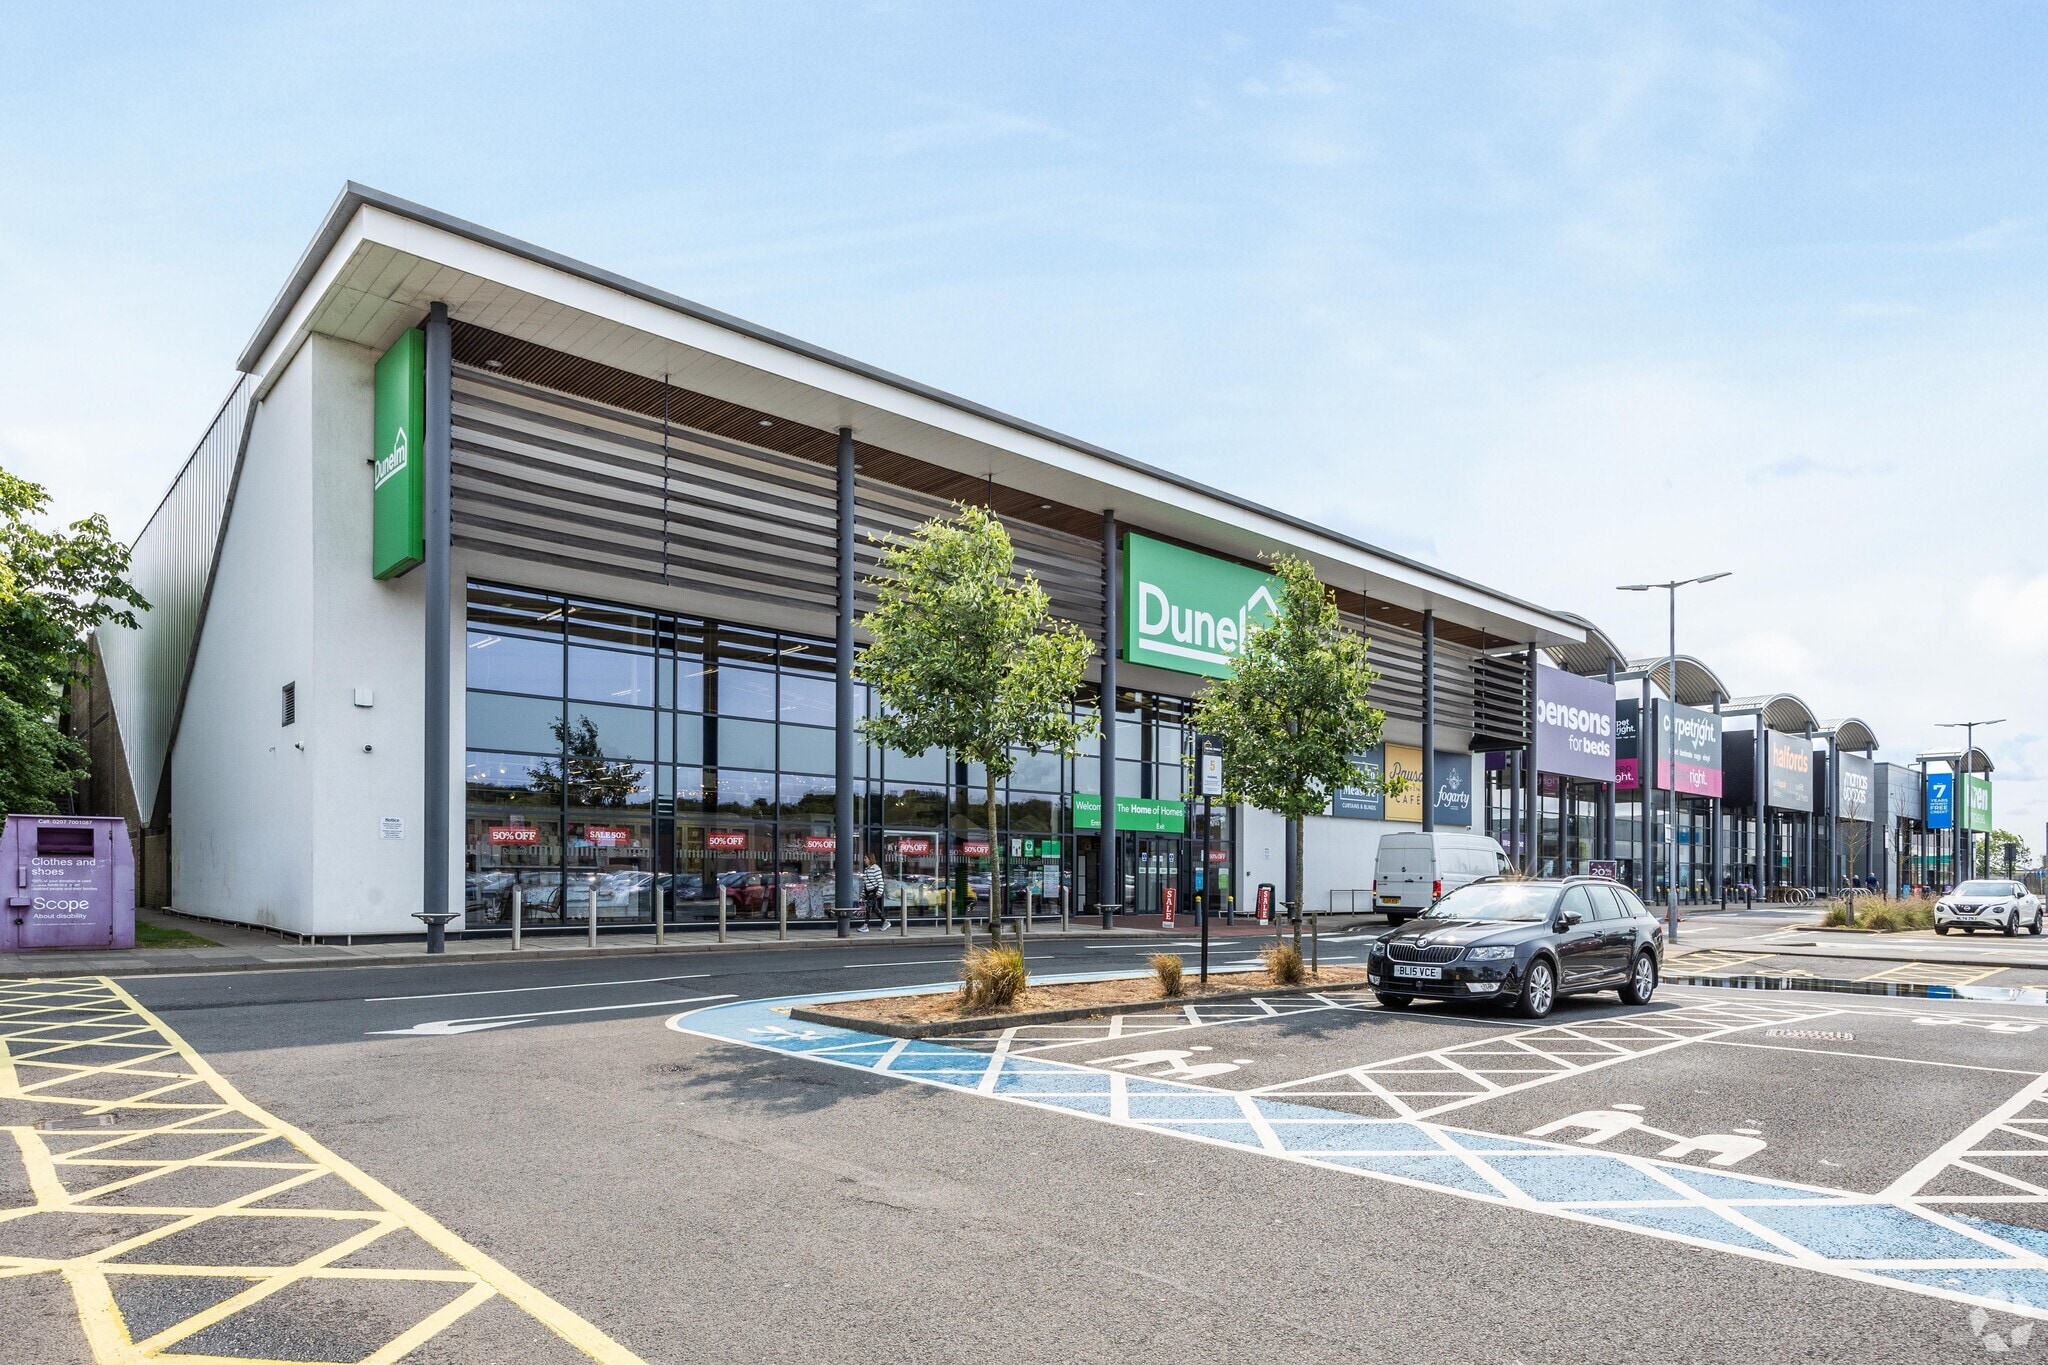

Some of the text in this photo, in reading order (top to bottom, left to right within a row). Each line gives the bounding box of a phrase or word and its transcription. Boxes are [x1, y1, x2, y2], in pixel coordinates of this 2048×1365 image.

[374, 441, 406, 484] Dunelm
[1139, 581, 1260, 662] Dunel
[1664, 715, 1716, 747] crpetright.
[1568, 735, 1610, 757] for beds
[1773, 742, 1808, 773] halfords
[1209, 760, 1216, 771] 5
[1689, 769, 1708, 788] right.
[1433, 784, 1470, 809] fogarty
[1933, 784, 1946, 798] 7
[1117, 803, 1130, 813] The
[1131, 804, 1152, 815] Home
[1152, 805, 1160, 815] of
[1161, 806, 1183, 817] Homes
[1156, 822, 1165, 830] Exit
[492, 831, 536, 841] 50% OFF
[589, 830, 610, 839] SALE
[709, 837, 744, 845] 50% OFF
[807, 840, 823, 848] 50%
[900, 844, 914, 852] 50%
[31, 857, 96, 866] Clothes and
[31, 868, 64, 876] shoes
[33, 896, 90, 913] Scope
[1165, 890, 1173, 920] SALE
[1399, 966, 1436, 977] BL15 VCE
